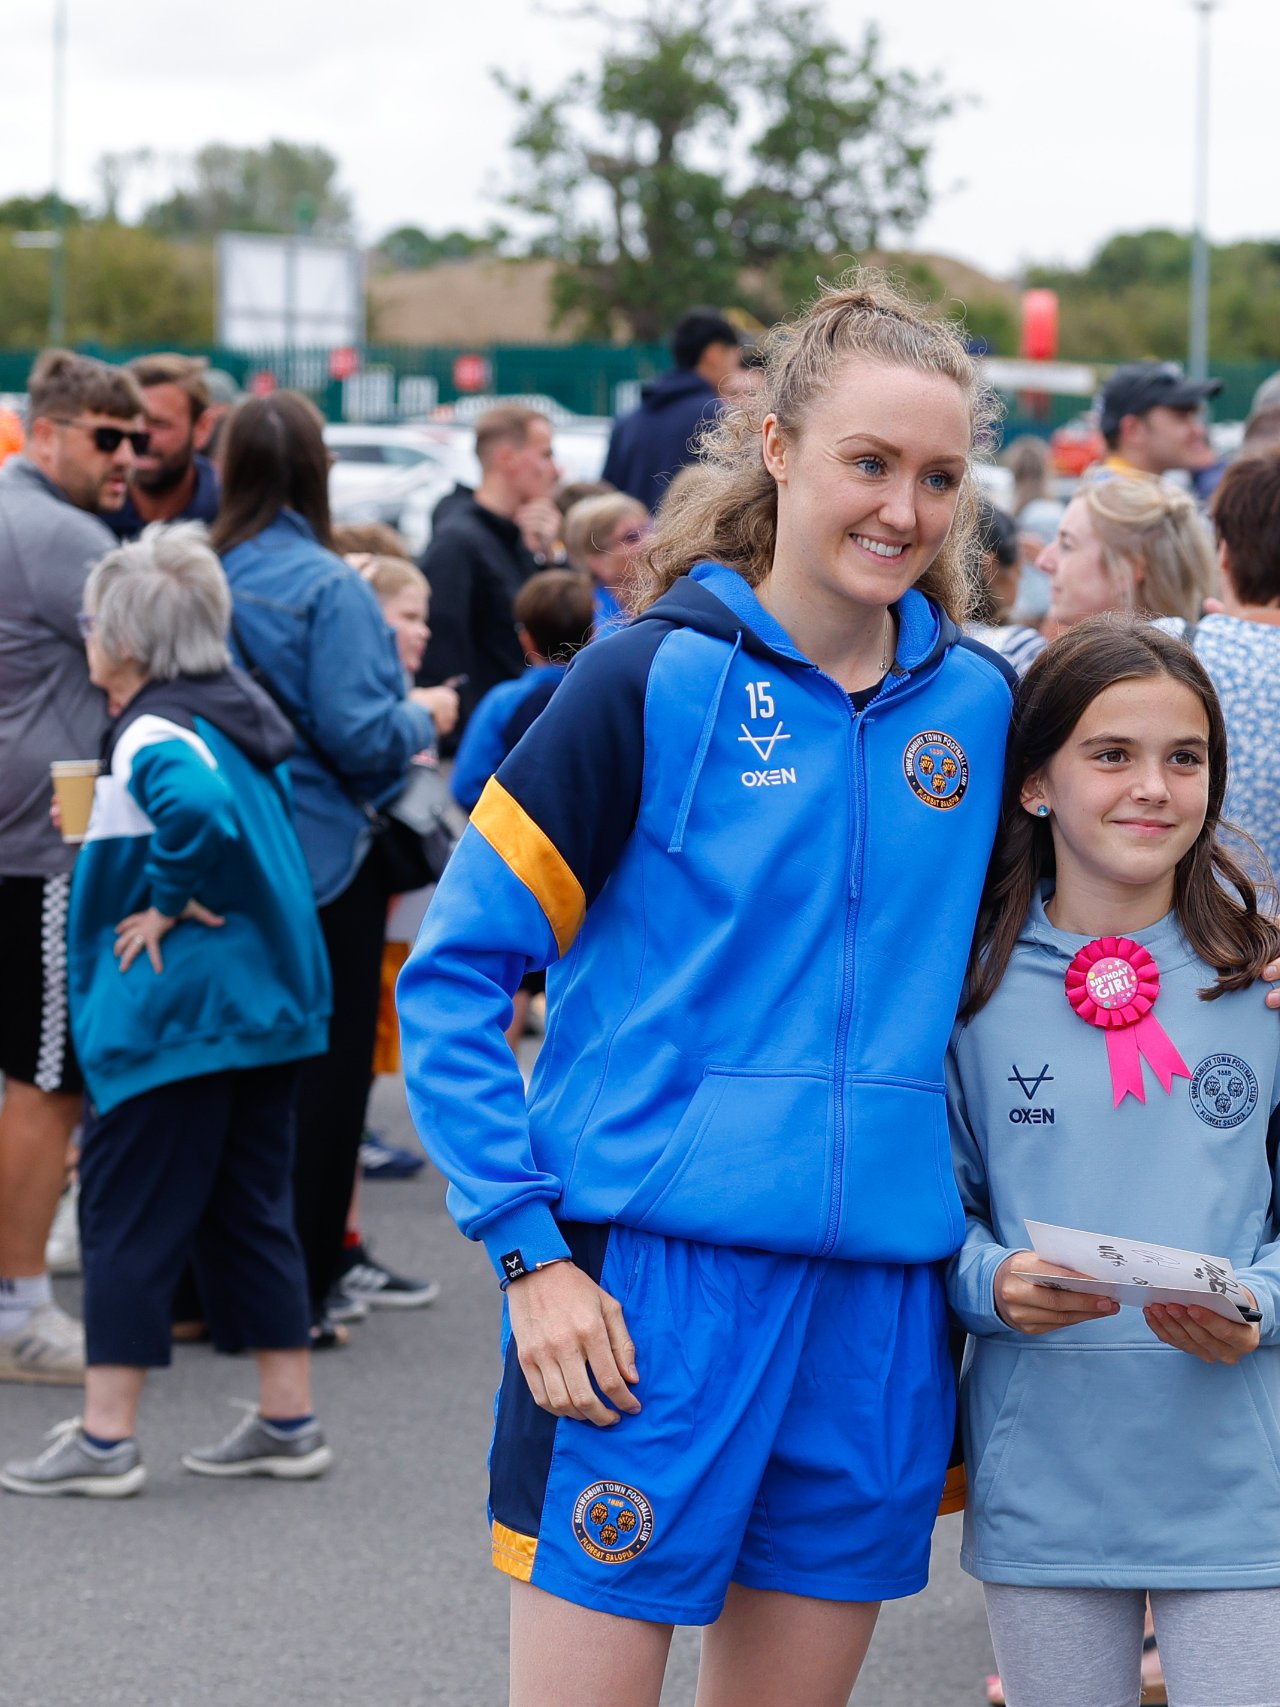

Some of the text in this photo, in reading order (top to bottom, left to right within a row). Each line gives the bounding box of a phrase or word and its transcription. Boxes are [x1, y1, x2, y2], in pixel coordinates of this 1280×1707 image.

[745, 681, 775, 719] 15
[905, 736, 925, 777] SHREWSBURY
[925, 733, 943, 742] TOWN
[943, 736, 967, 767] FOOTBALL
[741, 767, 797, 787] OXEN
[1089, 966, 1130, 988] BIRTHDAY
[1095, 975, 1134, 999] GIRL
[1191, 1056, 1257, 1104] SHREWSBURY TOWN FOOTBALL CLUB
[1008, 1108, 1055, 1125] OXEN
[1222, 1112, 1246, 1126] SALOPIA
[574, 1483, 652, 1542] SHREWSBURY TOWN FOOTBALL CLUB
[580, 1537, 635, 1561] FLOREAT SALOPIA
